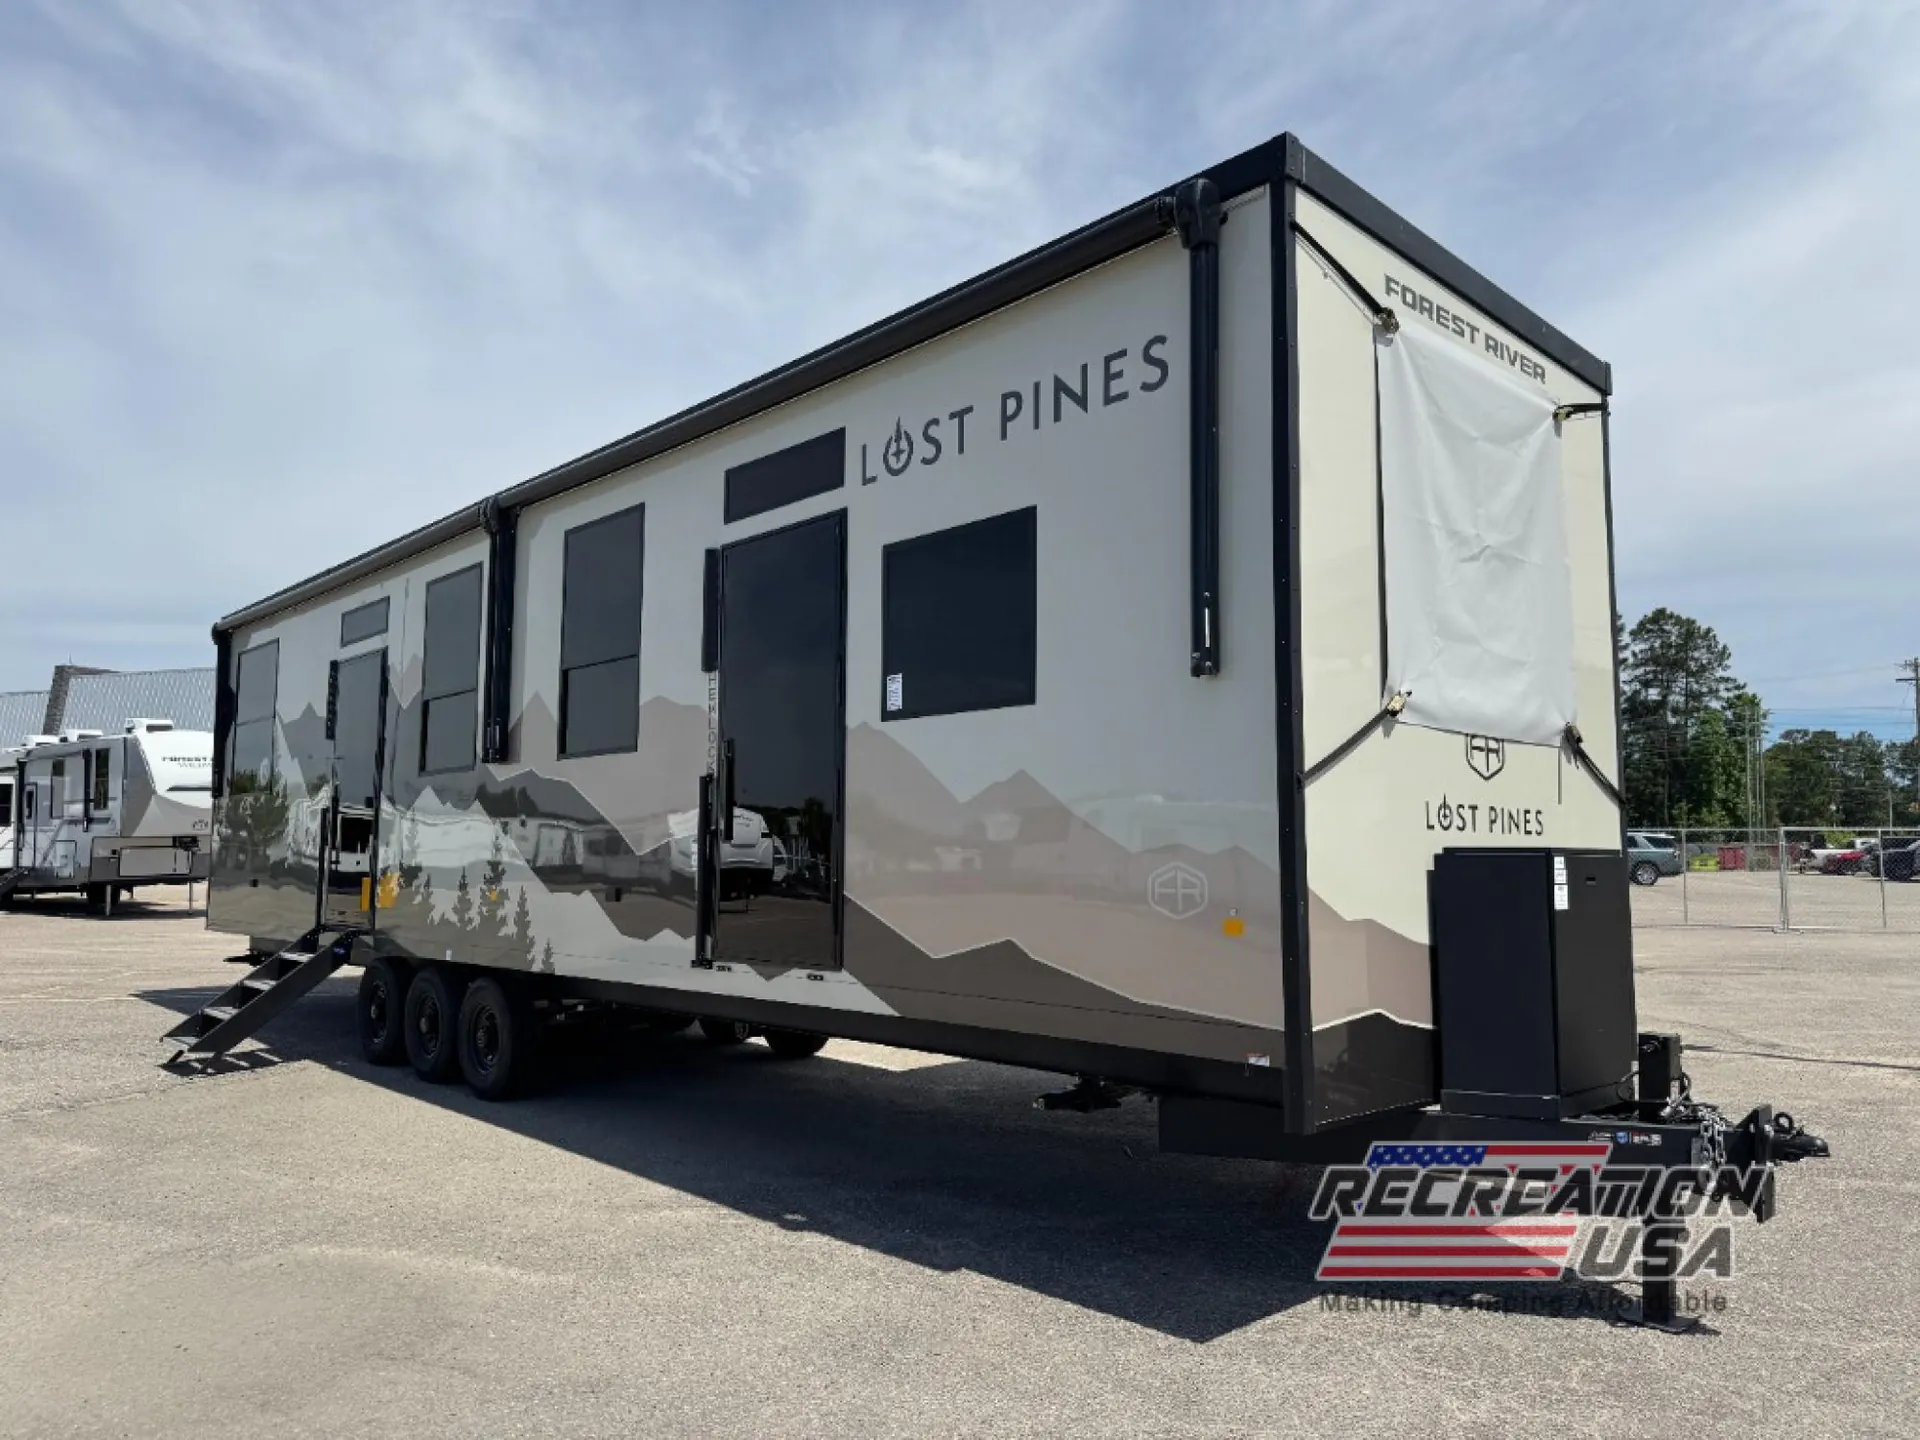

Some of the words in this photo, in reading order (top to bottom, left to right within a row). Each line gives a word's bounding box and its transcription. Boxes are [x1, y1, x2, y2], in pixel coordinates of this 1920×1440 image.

[1384, 273, 1480, 345] FOREST
[1484, 332, 1547, 385] RIVER
[861, 404, 974, 486] LOST
[1000, 334, 1170, 441] PINES
[1425, 793, 1478, 833] LOST
[1488, 805, 1544, 836] PINES
